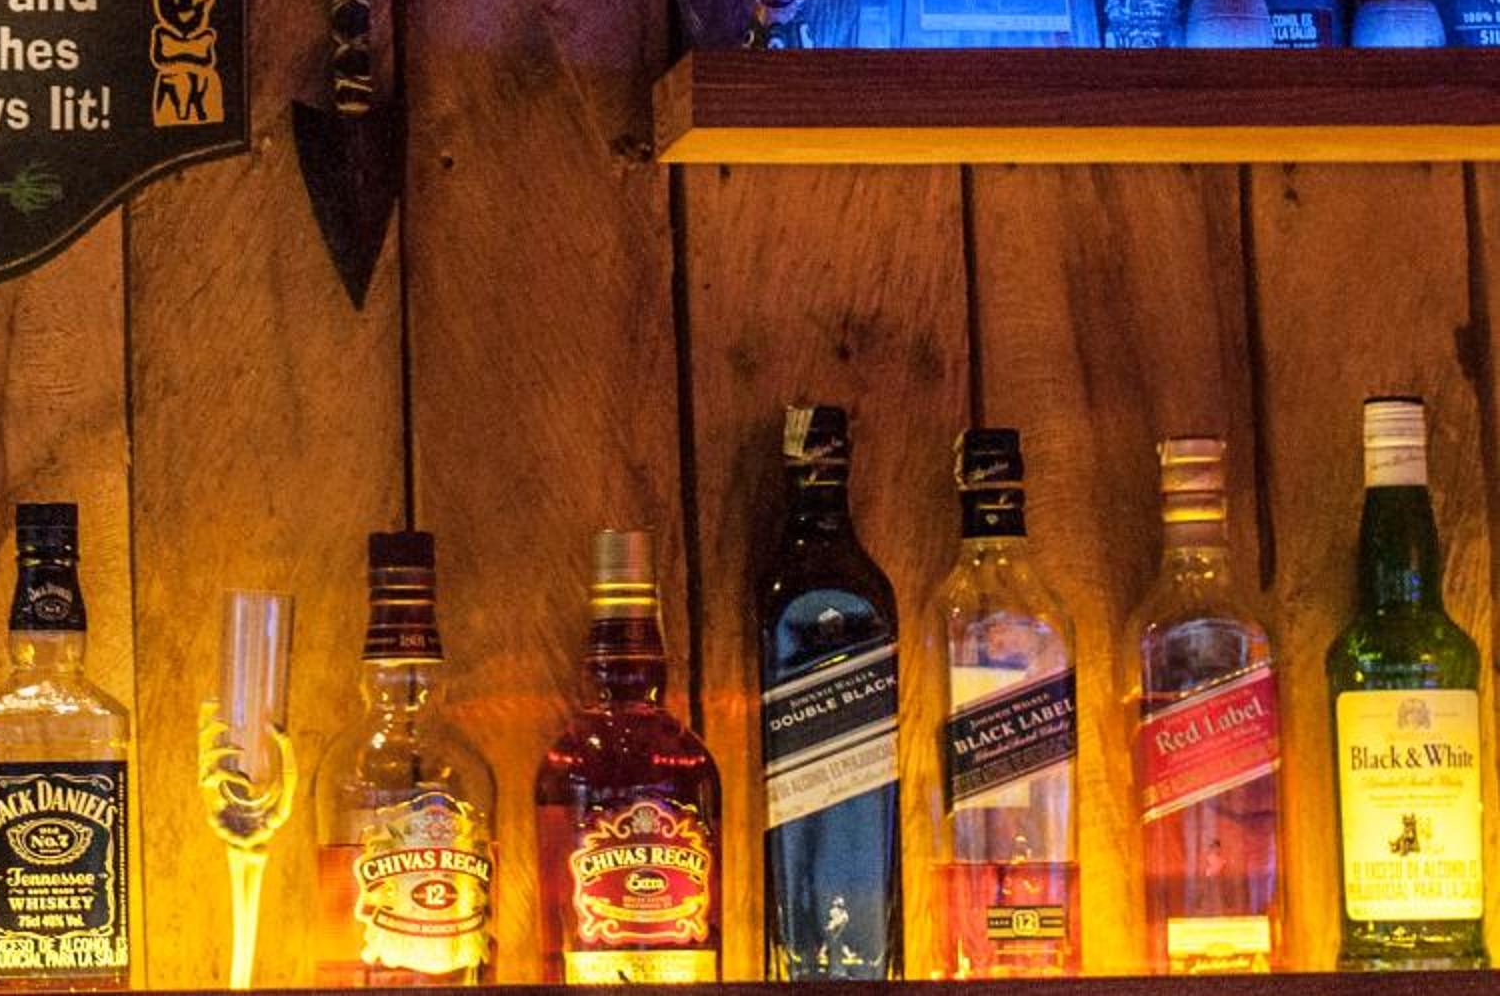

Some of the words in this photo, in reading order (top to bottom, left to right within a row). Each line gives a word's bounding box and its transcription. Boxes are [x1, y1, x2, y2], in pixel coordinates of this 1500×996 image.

[49, 85, 112, 131] lit!
[769, 697, 838, 732] DOUBLE
[841, 674, 898, 705] BLACK
[954, 721, 1016, 756] BLACK
[1017, 698, 1075, 731] LABEL
[1156, 721, 1202, 756] Red
[1202, 695, 1266, 734] Label
[1350, 744, 1403, 771] Black
[1405, 746, 1422, 769] &
[1422, 743, 1475, 769] White
[35, 780, 119, 829] DANIEL'S
[6, 867, 95, 887] Tennessee
[361, 850, 437, 880] CHIVAS
[440, 850, 490, 882] REGAL
[579, 847, 648, 878] CHIVAS
[652, 847, 705, 873] REGAL
[7, 896, 95, 911] WHISKEY
[425, 884, 445, 905] 12
[1018, 914, 1035, 931] 12
